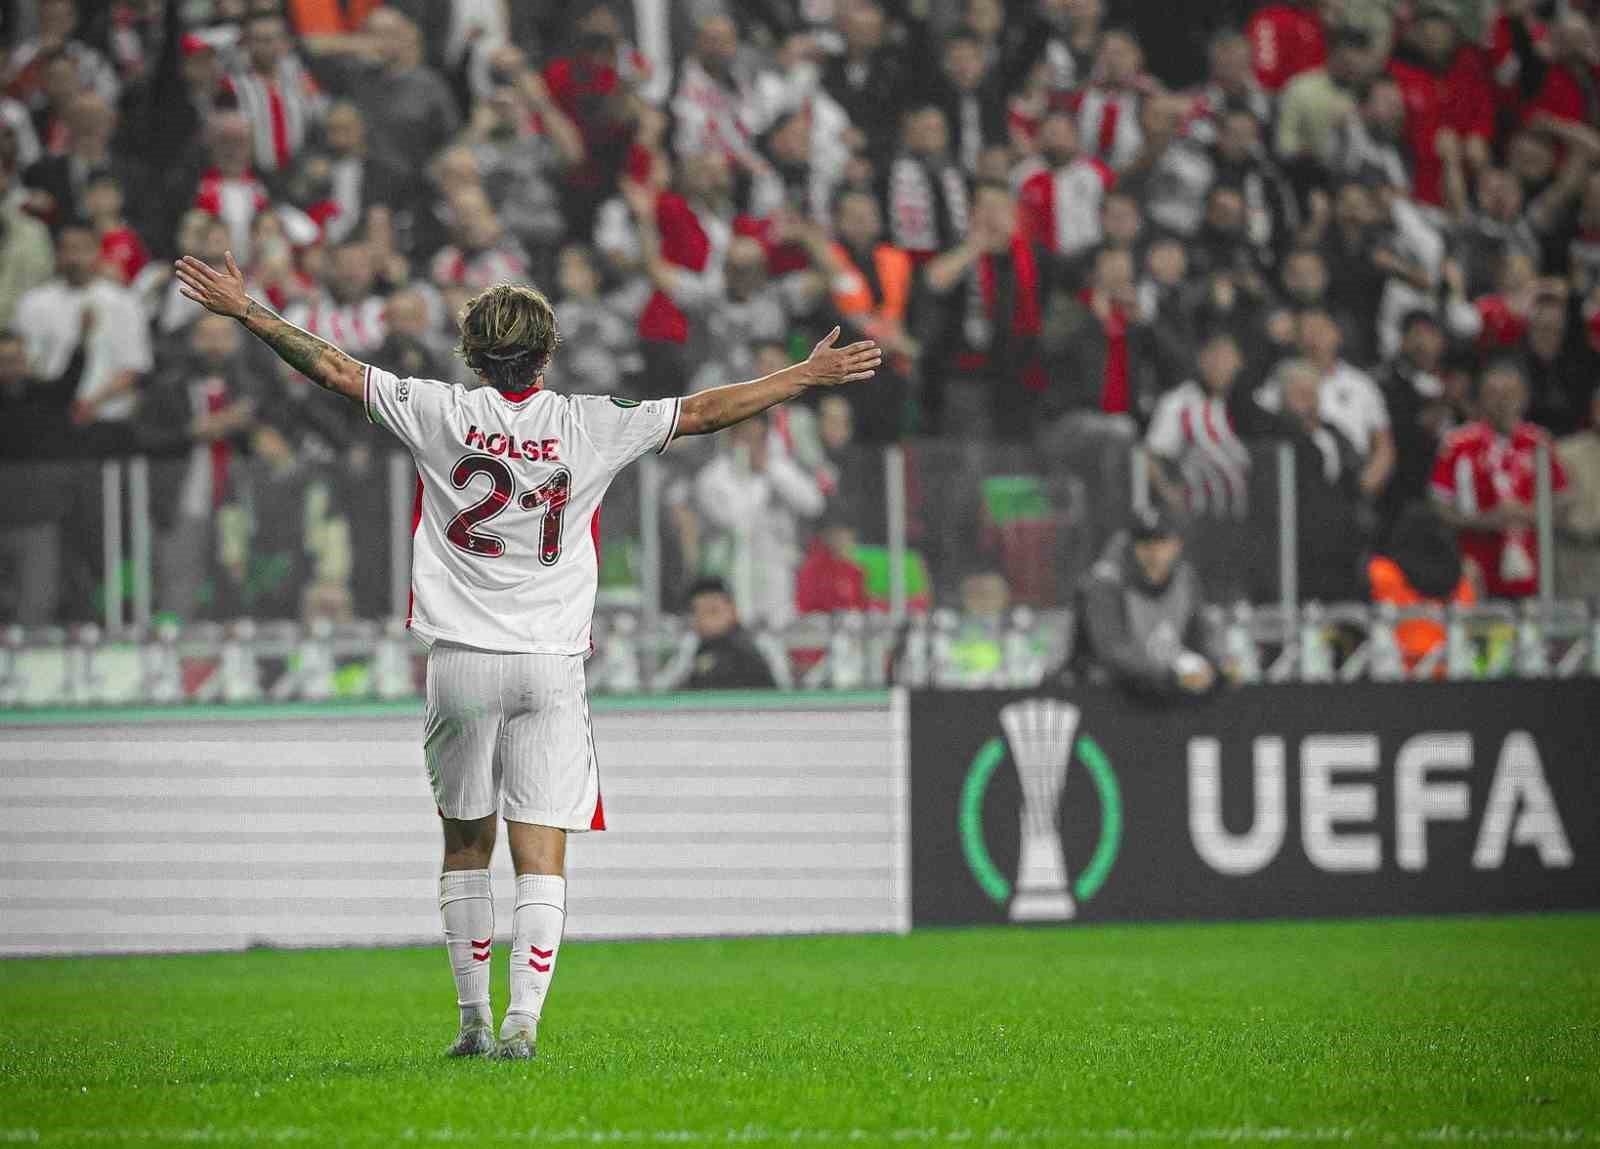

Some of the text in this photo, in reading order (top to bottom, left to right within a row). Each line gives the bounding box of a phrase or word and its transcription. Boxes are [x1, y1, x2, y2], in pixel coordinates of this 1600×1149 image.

[465, 425, 560, 461] HOLSE
[445, 453, 571, 566] 21
[1187, 730, 1573, 876] UEFA
